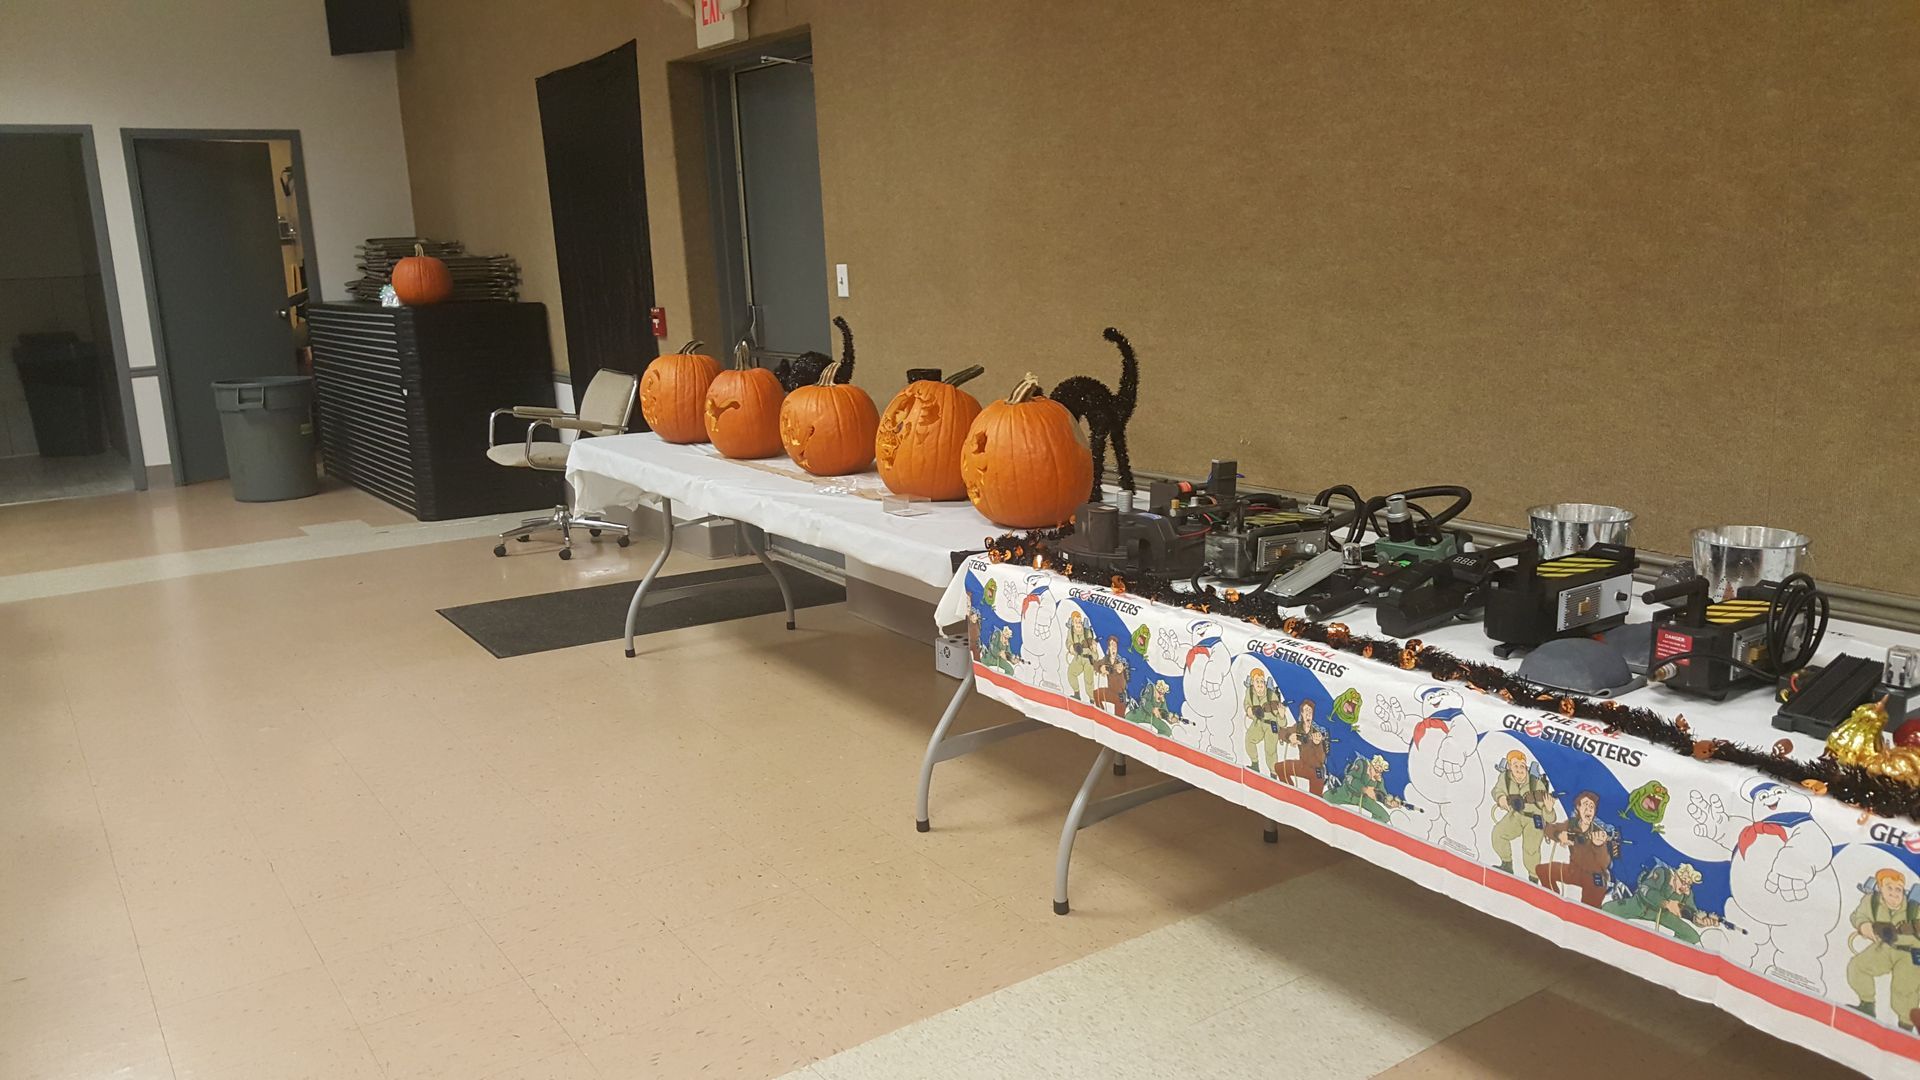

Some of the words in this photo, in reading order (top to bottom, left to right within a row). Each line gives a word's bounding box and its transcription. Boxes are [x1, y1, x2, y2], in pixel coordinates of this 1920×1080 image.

[702, 0, 725, 26] EXI
[1247, 639, 1347, 678] GHOSTBUSTERS
[1277, 638, 1304, 648] THE
[1302, 644, 1336, 660] REAL
[1540, 712, 1577, 727] THE
[1502, 714, 1643, 768] GHOSTBUSTERS
